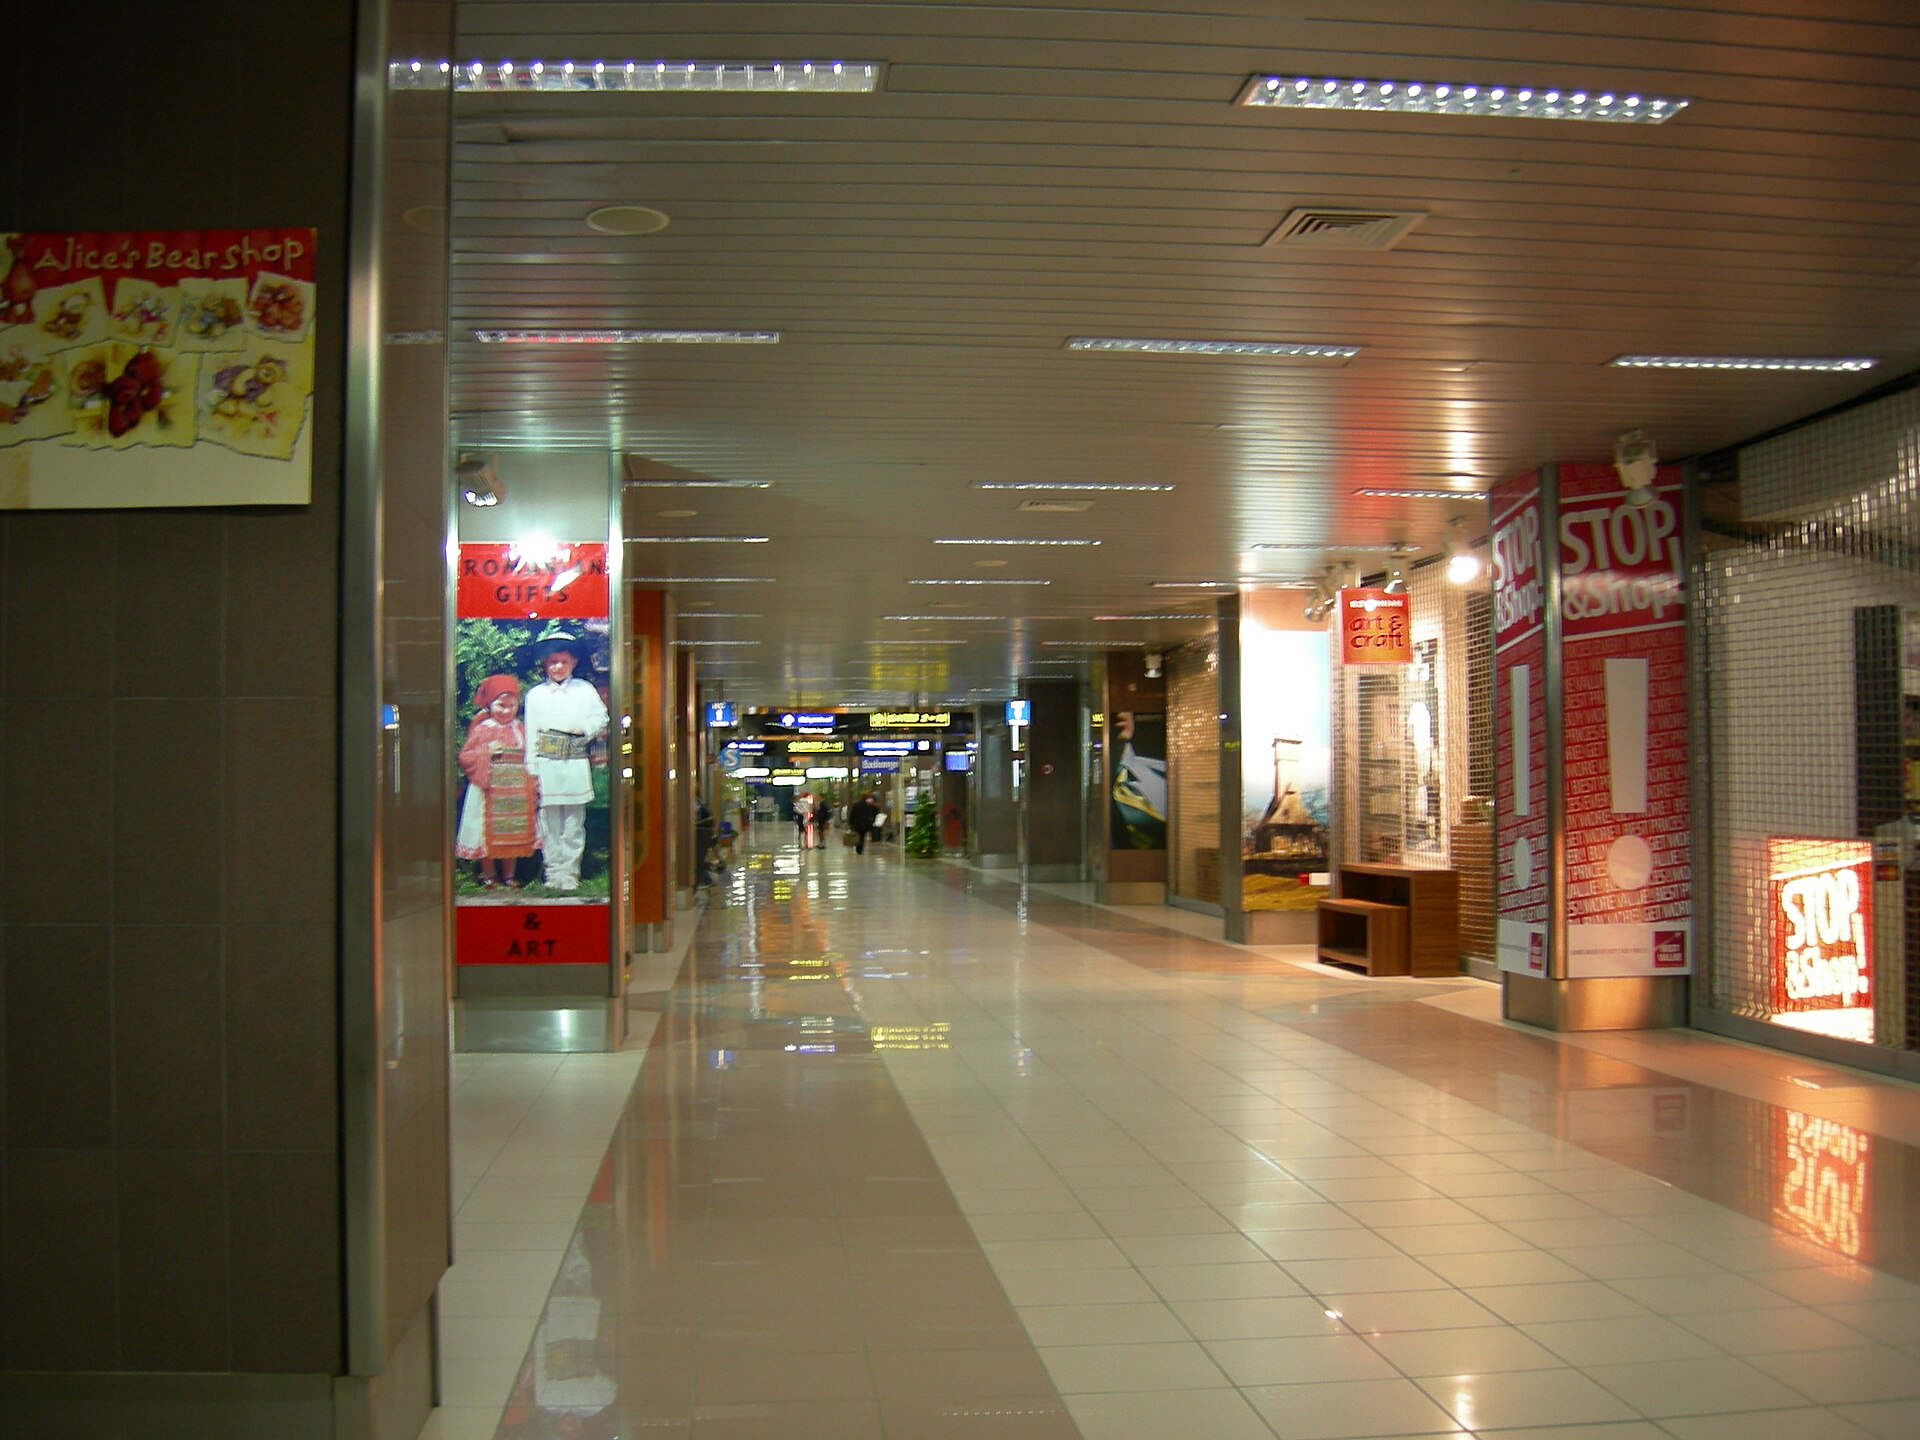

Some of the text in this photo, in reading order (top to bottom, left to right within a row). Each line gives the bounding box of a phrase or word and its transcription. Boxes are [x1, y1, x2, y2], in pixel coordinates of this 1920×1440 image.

[34, 237, 141, 272] Alice's
[145, 241, 217, 271] Bear
[1492, 505, 1539, 592] STOP
[1560, 498, 1676, 575] STOP
[495, 584, 569, 603] GIFTS
[1350, 631, 1405, 651] craft
[524, 912, 541, 931] &
[1781, 868, 1860, 950] STOP
[507, 939, 557, 957] ART
